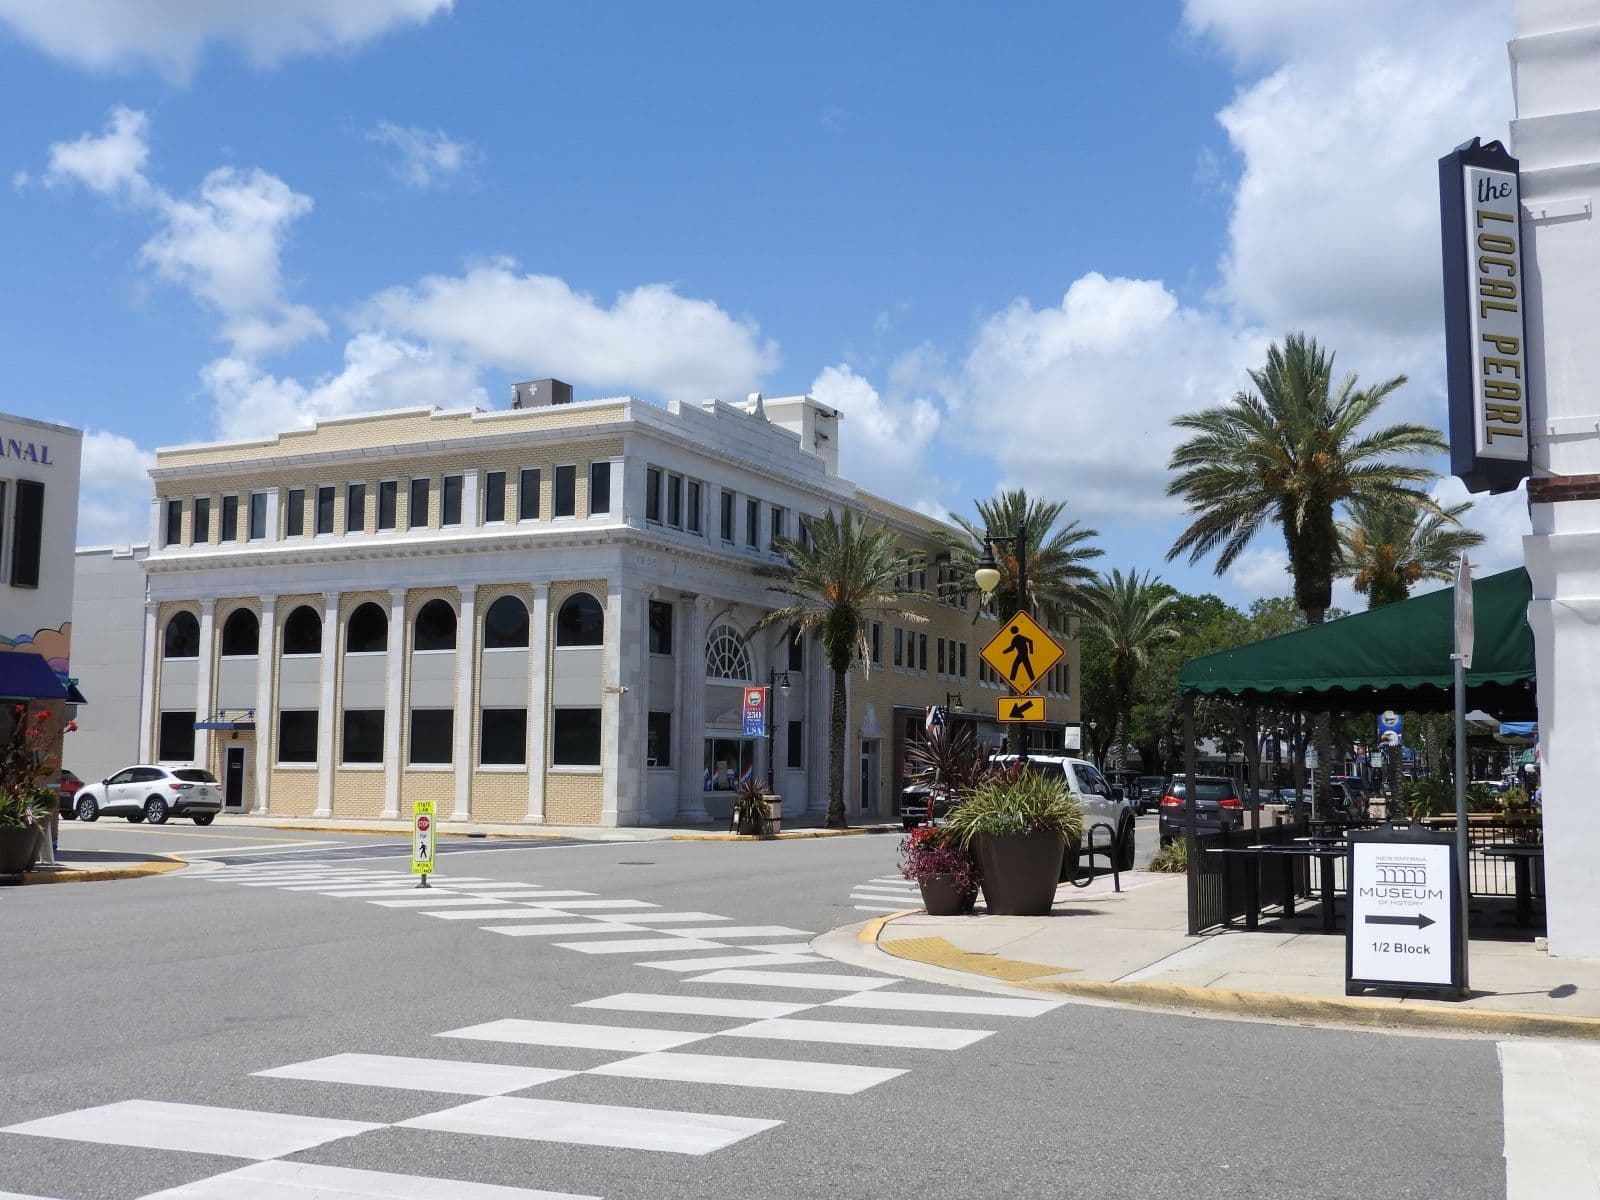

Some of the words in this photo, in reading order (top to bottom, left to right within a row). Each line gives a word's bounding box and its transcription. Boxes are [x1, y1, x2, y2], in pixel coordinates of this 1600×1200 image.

[1477, 176, 1512, 203] the
[1476, 209, 1518, 320] LOCAL
[1482, 333, 1524, 445] PEARL
[746, 711, 762, 719] 250
[1359, 887, 1443, 900] MUSEUM
[1372, 942, 1390, 953] 1/2
[1394, 943, 1431, 954] Block
